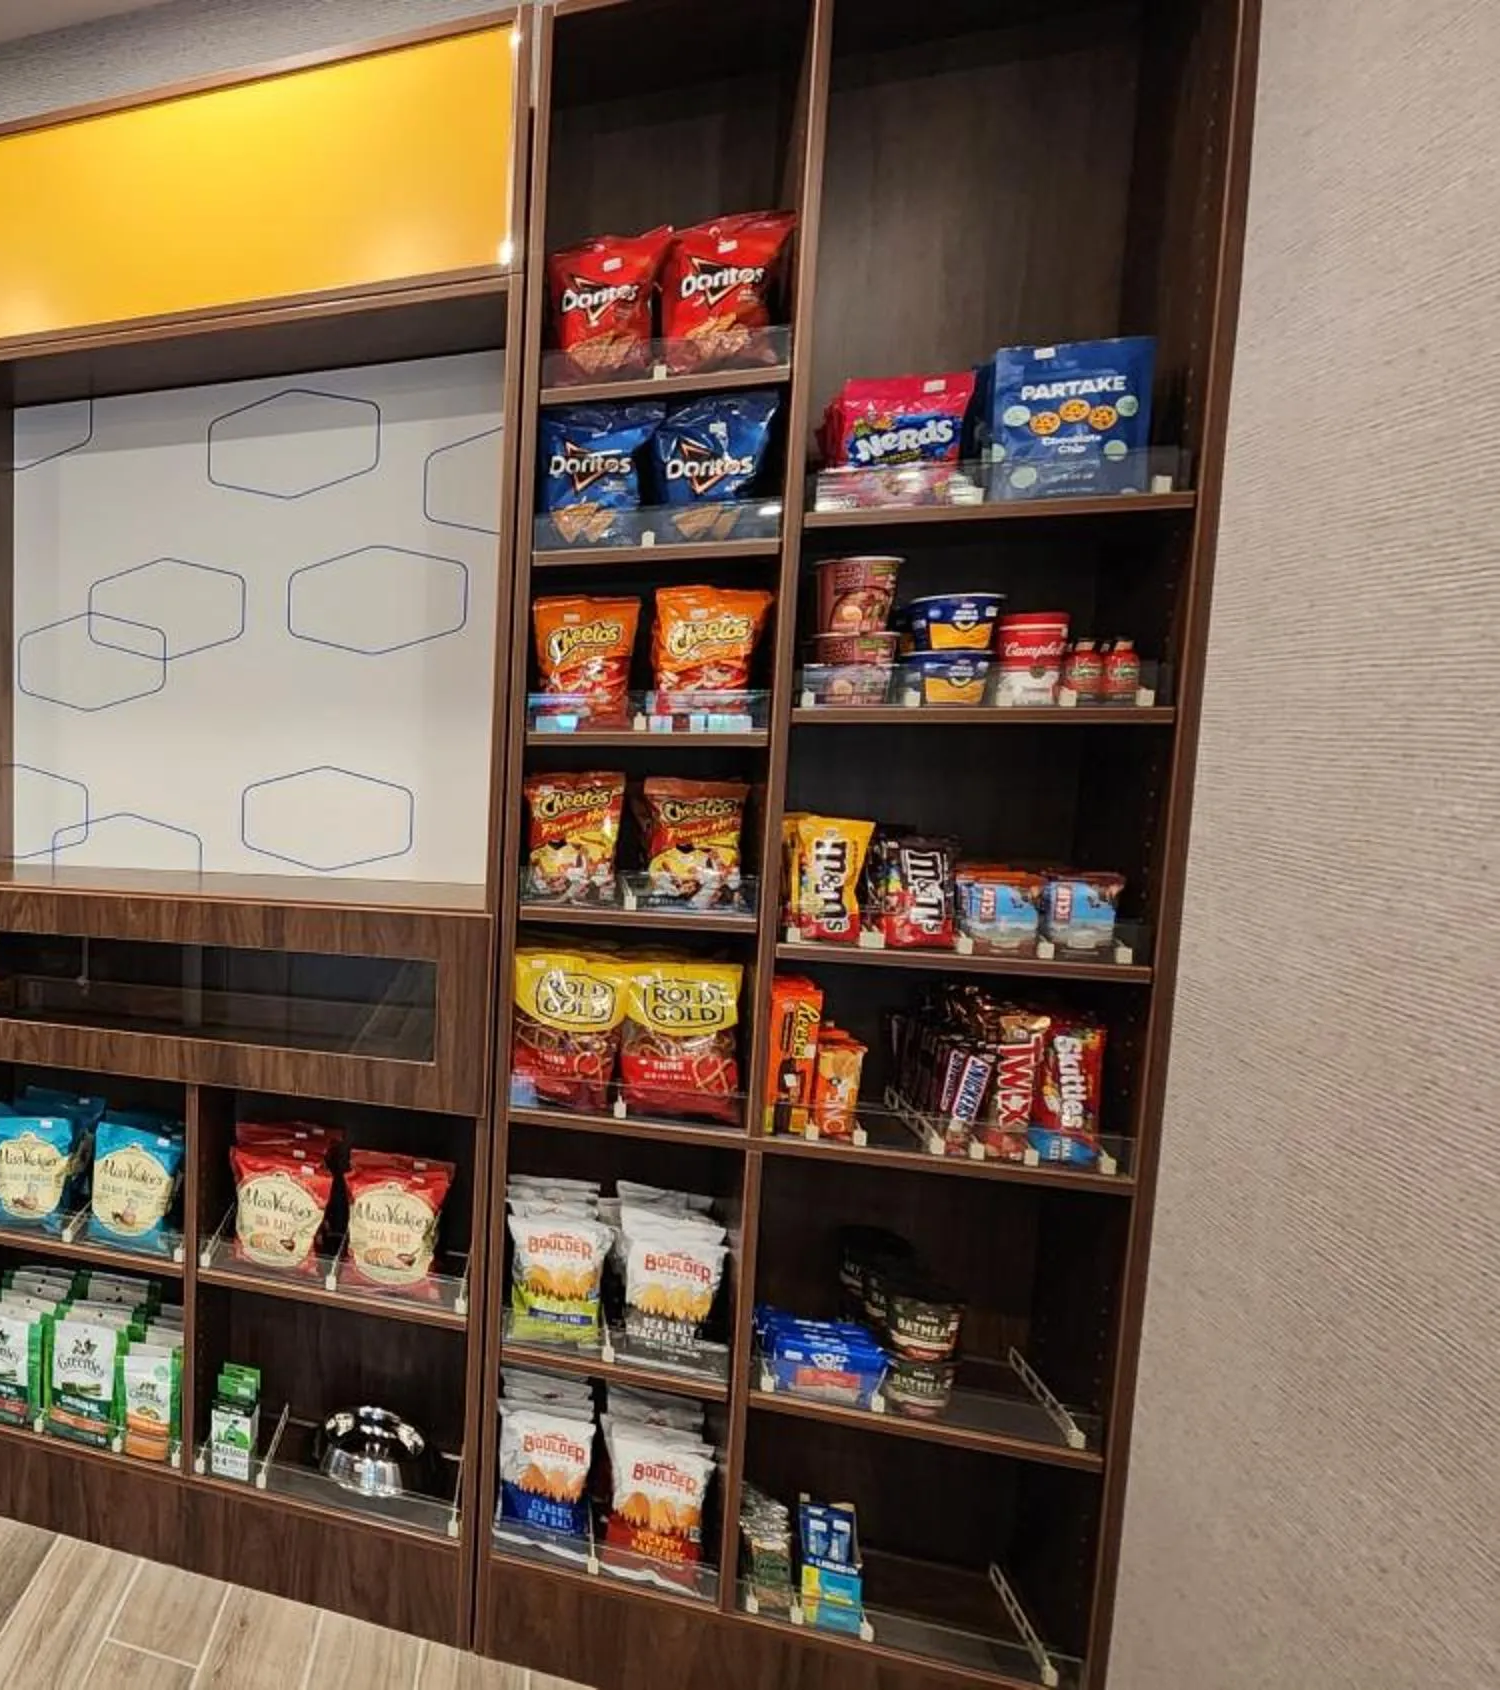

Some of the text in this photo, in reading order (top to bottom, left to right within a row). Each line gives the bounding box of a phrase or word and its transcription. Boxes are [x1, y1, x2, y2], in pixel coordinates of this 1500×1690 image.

[682, 267, 765, 298] Doritos
[561, 283, 639, 313] Doritos
[1021, 375, 1127, 400] PARTAKE
[549, 455, 632, 476] Doritos
[666, 455, 755, 480] Doritos
[547, 622, 624, 665] Cheetos
[669, 615, 754, 660] Cheetos
[538, 787, 613, 820] Cheetos
[663, 799, 737, 822] Cheetos
[653, 985, 721, 1005] ROLD
[651, 1004, 717, 1022] GOLD
[997, 1033, 1043, 1129] TWIX
[1053, 1034, 1088, 1129] Skittles
[528, 1235, 593, 1260] BOULDER
[644, 1252, 712, 1285] BOULDER
[524, 1435, 586, 1464] BOULDER
[632, 1463, 698, 1495] BOULDER
